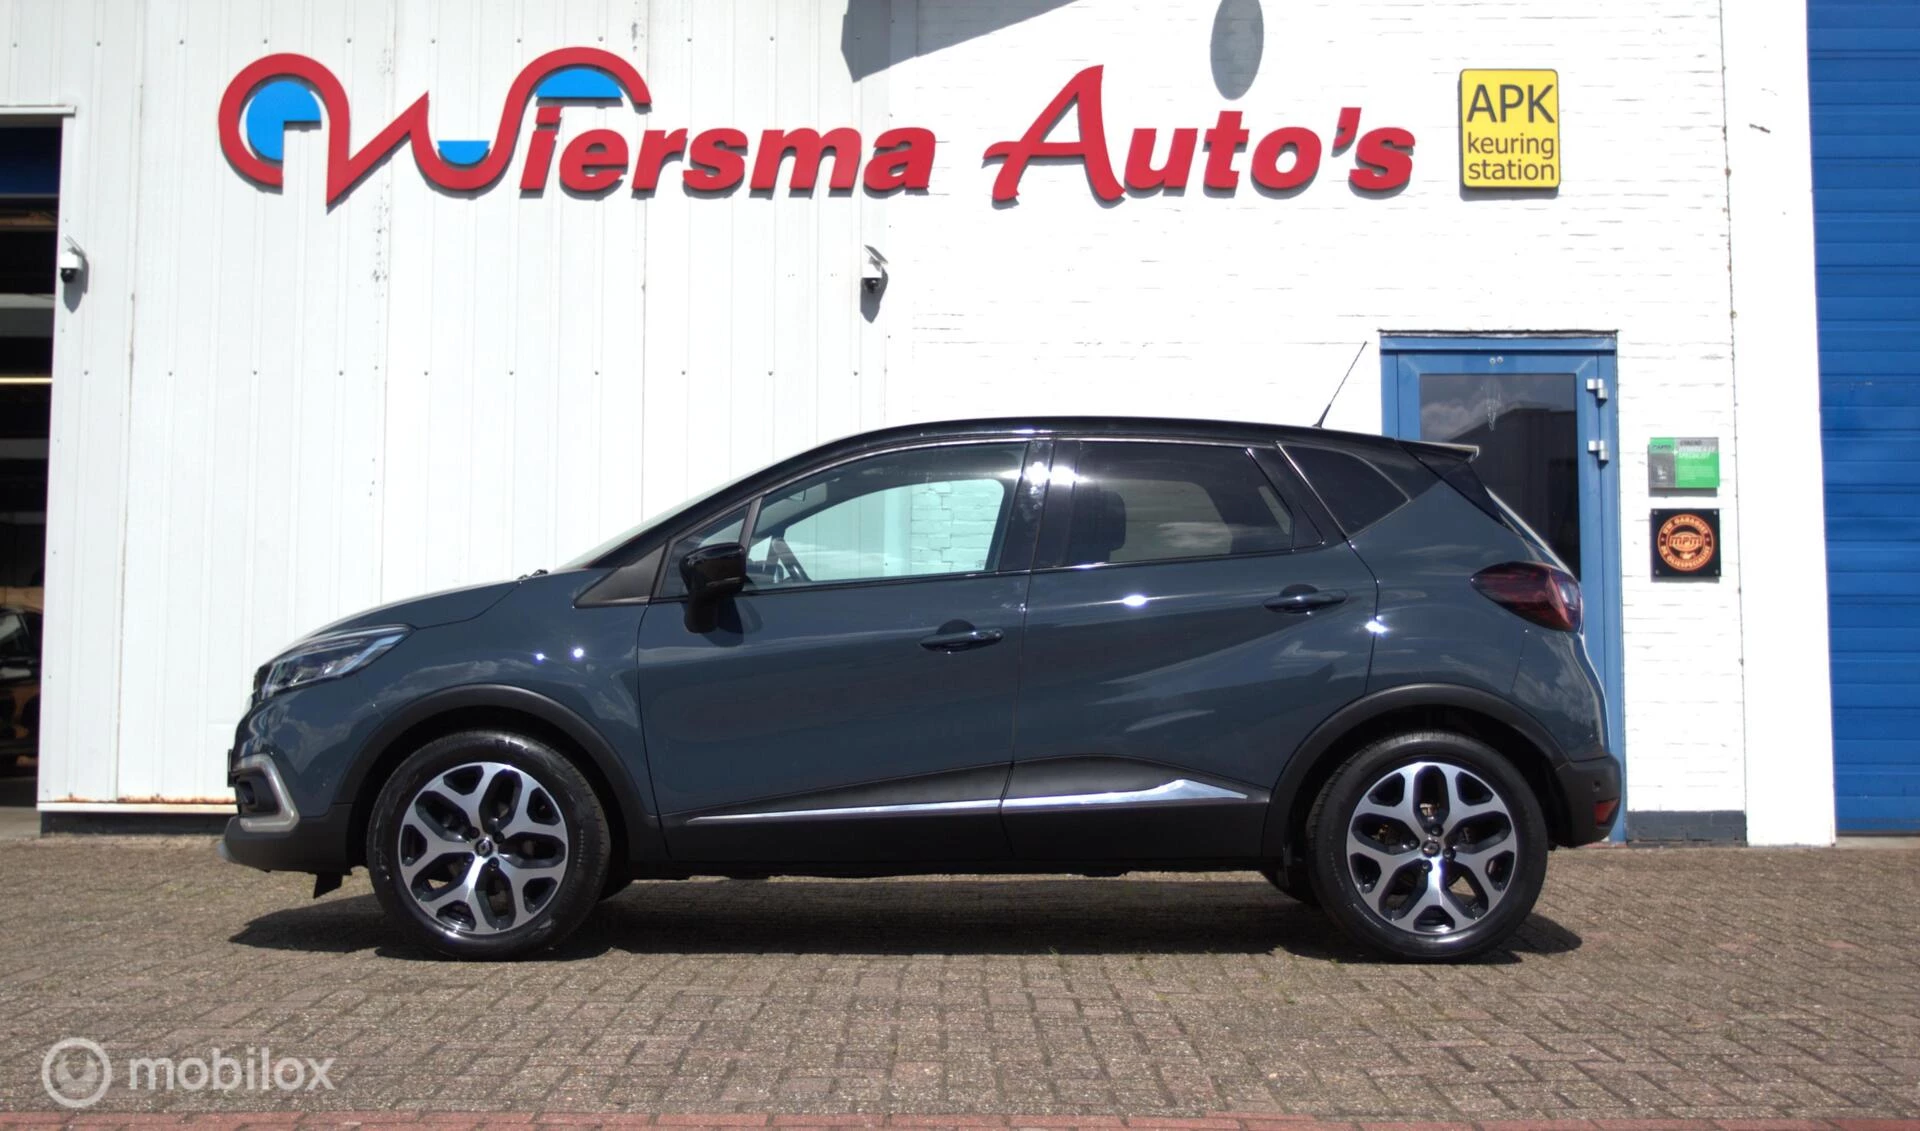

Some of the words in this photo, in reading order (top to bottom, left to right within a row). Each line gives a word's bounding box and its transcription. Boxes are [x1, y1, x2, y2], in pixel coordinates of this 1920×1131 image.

[1466, 84, 1555, 123] APK
[218, 47, 937, 206] Wiersma
[983, 65, 1416, 201] Auto's
[1468, 131, 1554, 160] keuring
[1468, 159, 1555, 181] station
